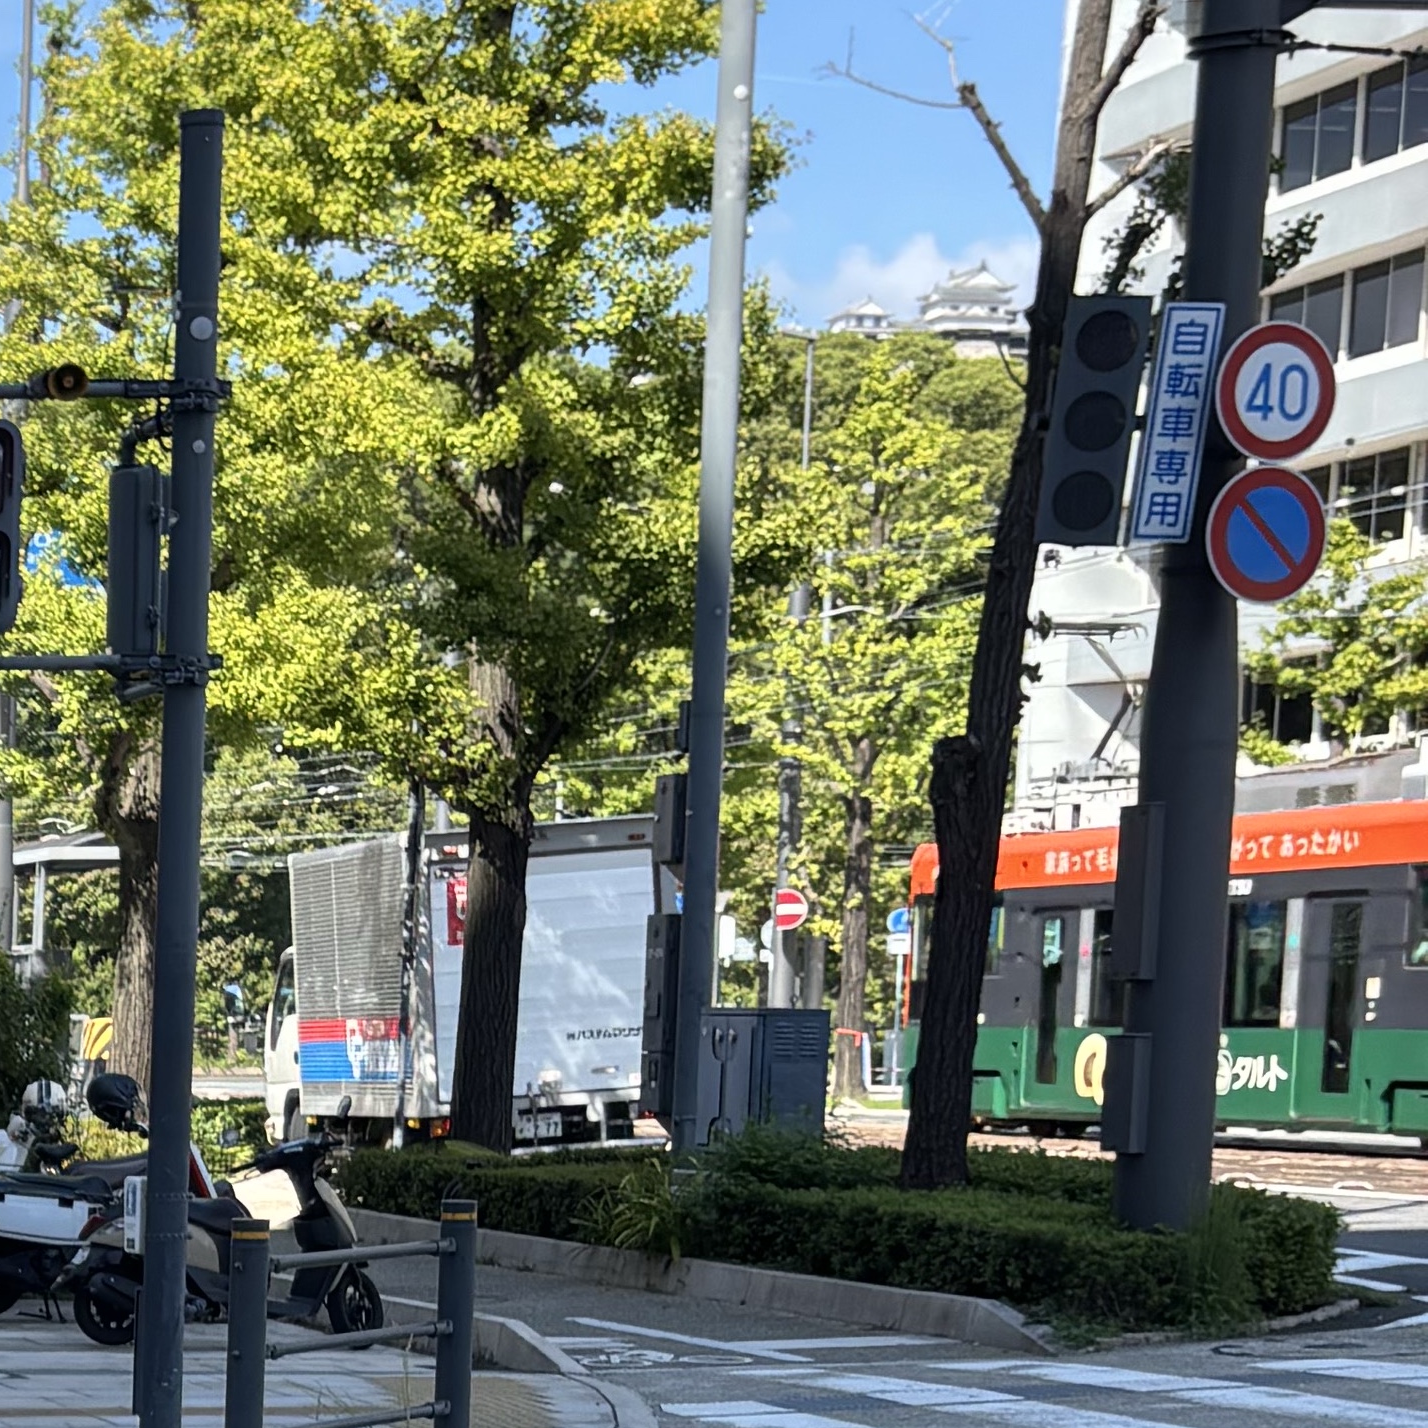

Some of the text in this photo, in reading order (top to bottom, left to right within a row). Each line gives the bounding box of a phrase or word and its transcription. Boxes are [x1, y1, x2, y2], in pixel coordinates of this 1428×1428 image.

[1144, 319, 1209, 529] 自転車専用
[1245, 362, 1309, 422] 40
